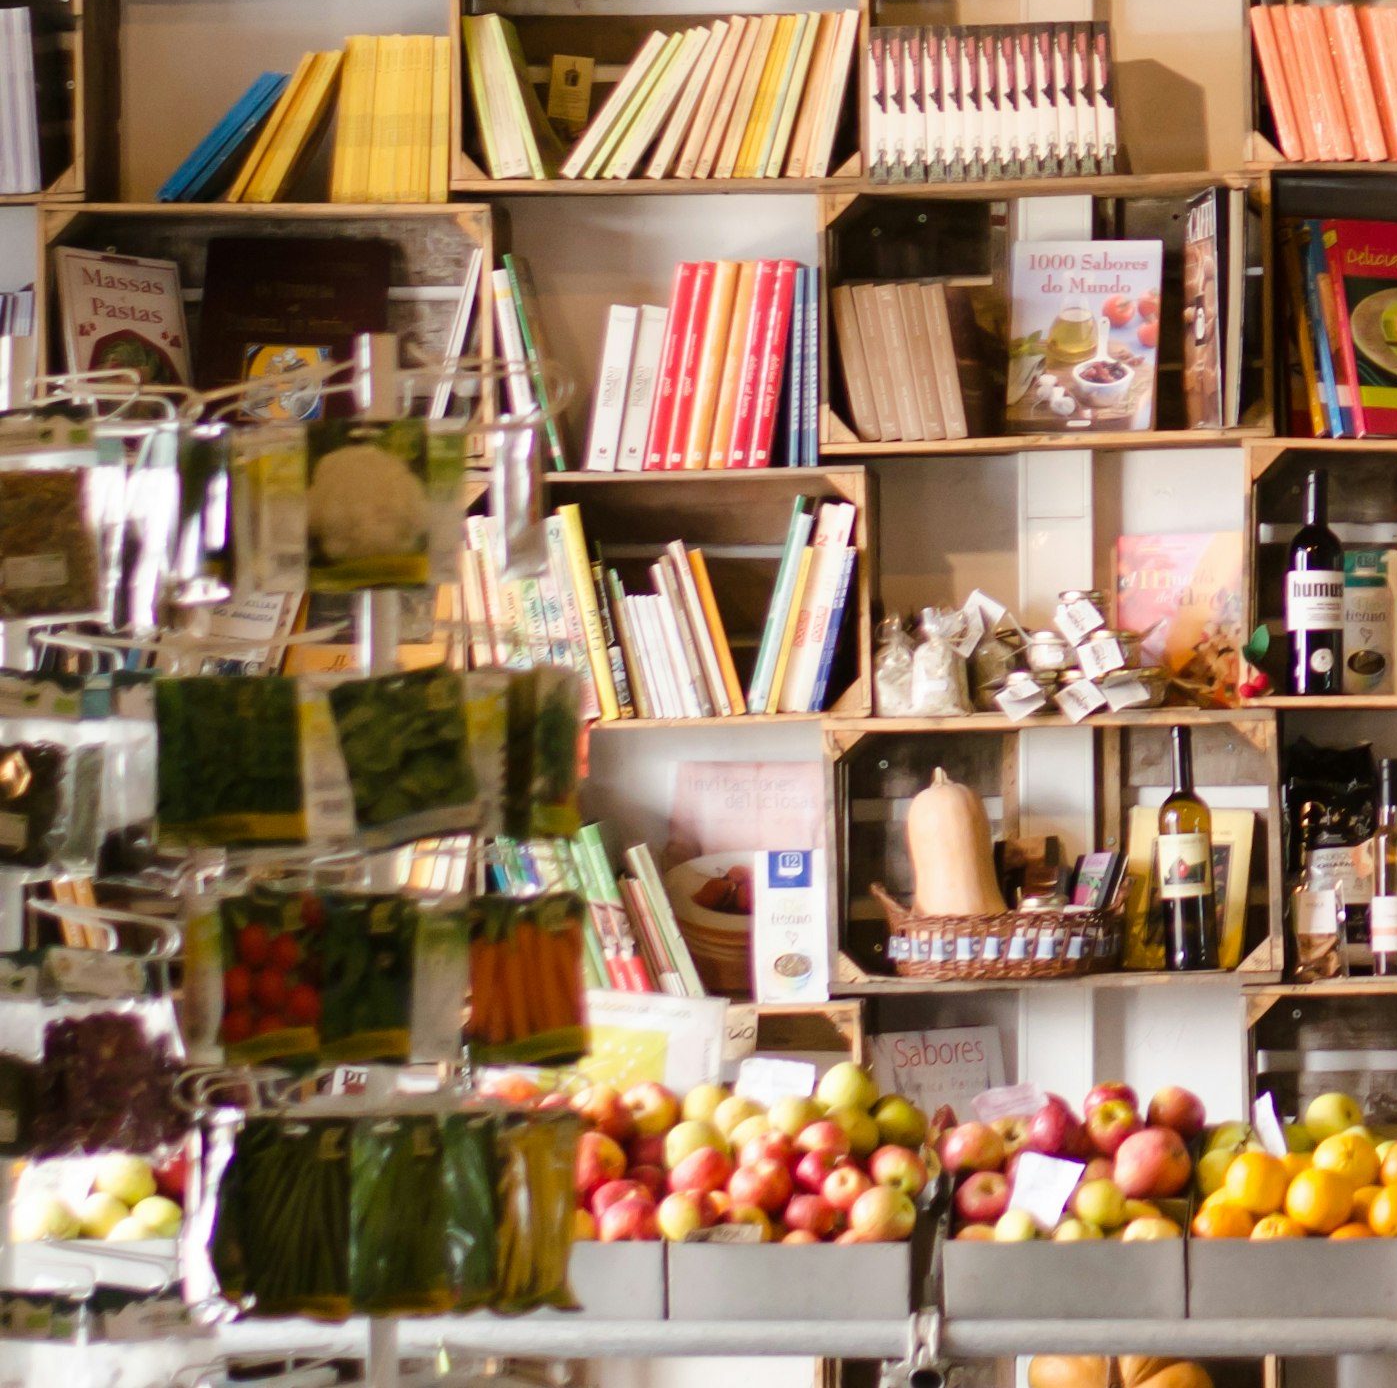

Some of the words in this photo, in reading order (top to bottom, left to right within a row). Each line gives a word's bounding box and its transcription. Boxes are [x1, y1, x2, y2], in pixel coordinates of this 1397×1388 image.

[1028, 254, 1075, 272] 1000
[1081, 253, 1148, 272] Sabores
[81, 265, 164, 297] Massas
[1041, 274, 1063, 294] do
[1069, 274, 1131, 294] Mundo
[91, 297, 164, 325] Pastas
[783, 855, 800, 868] 12
[894, 1036, 985, 1070] Sabores
